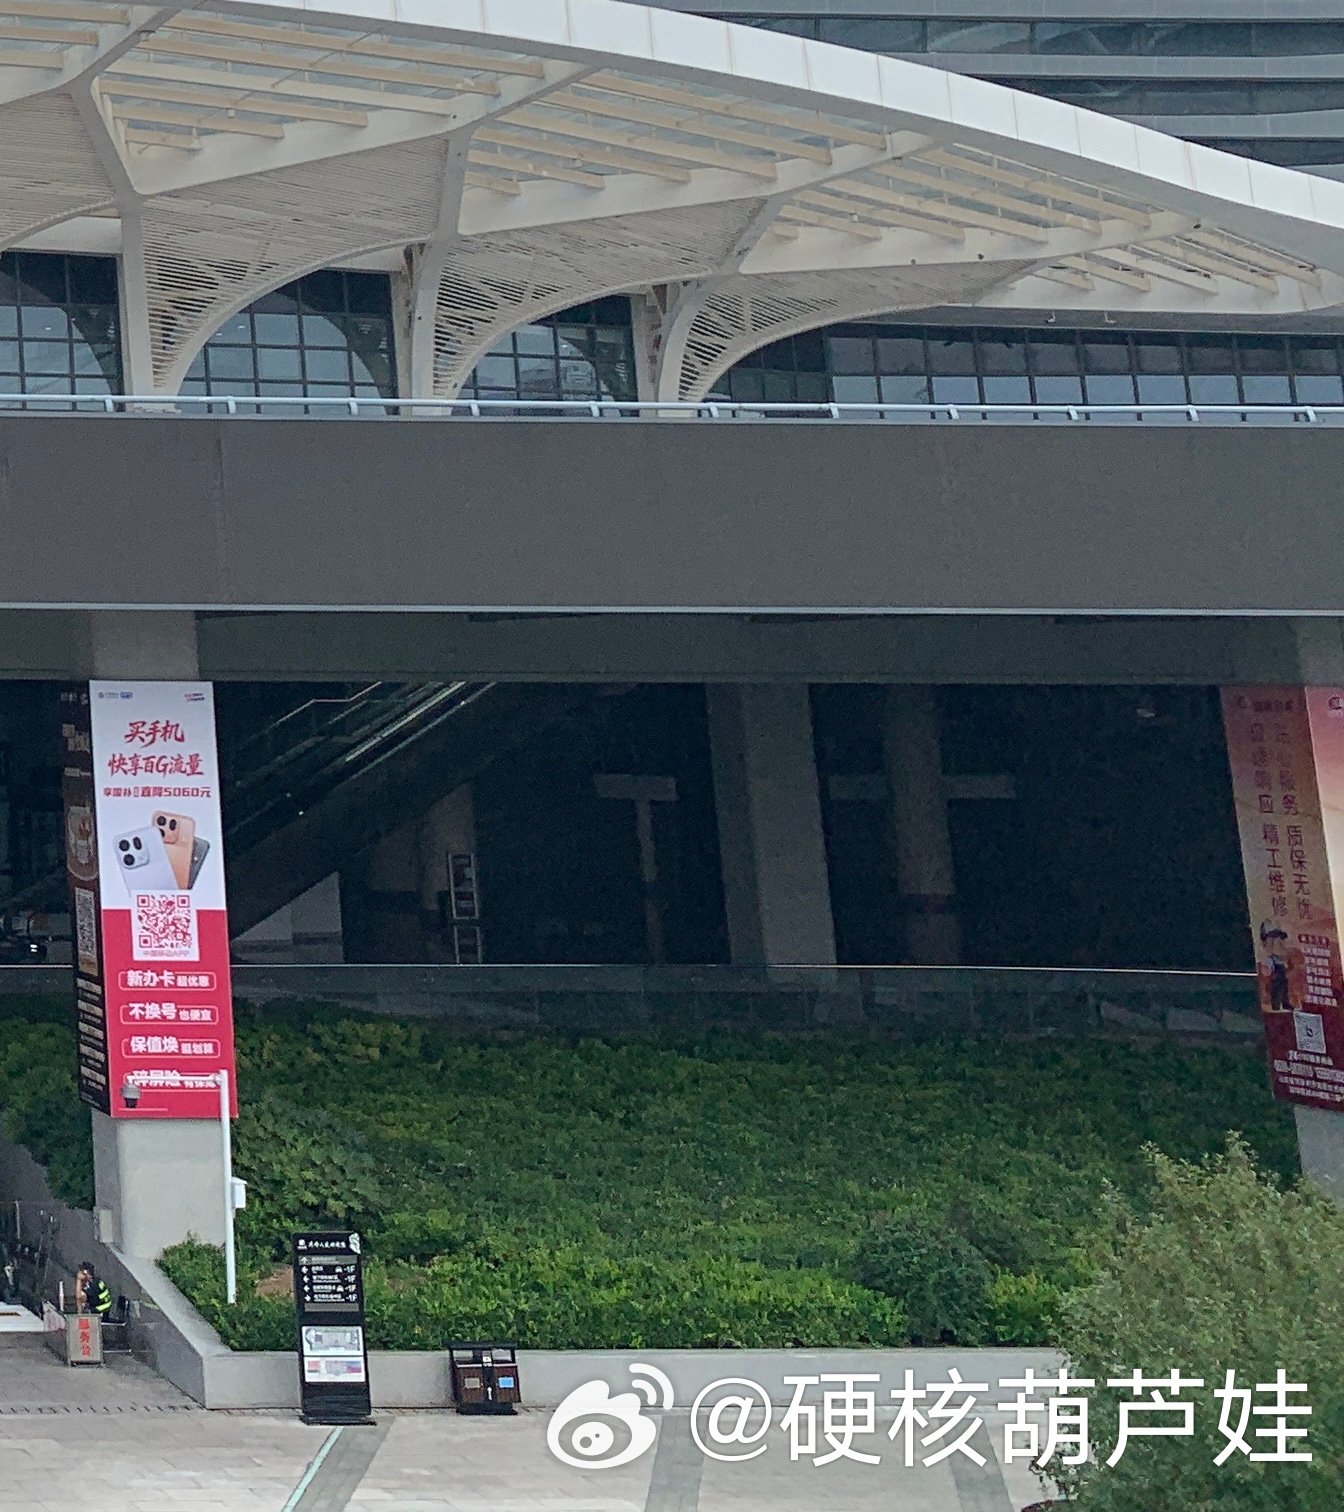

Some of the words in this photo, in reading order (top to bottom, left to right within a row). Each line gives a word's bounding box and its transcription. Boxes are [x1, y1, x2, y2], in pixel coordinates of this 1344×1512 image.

[124, 720, 185, 748] 买手机
[108, 753, 204, 778] 快享百G流量
[127, 970, 175, 987] 新办卡
[128, 1003, 177, 1020] 不换号
